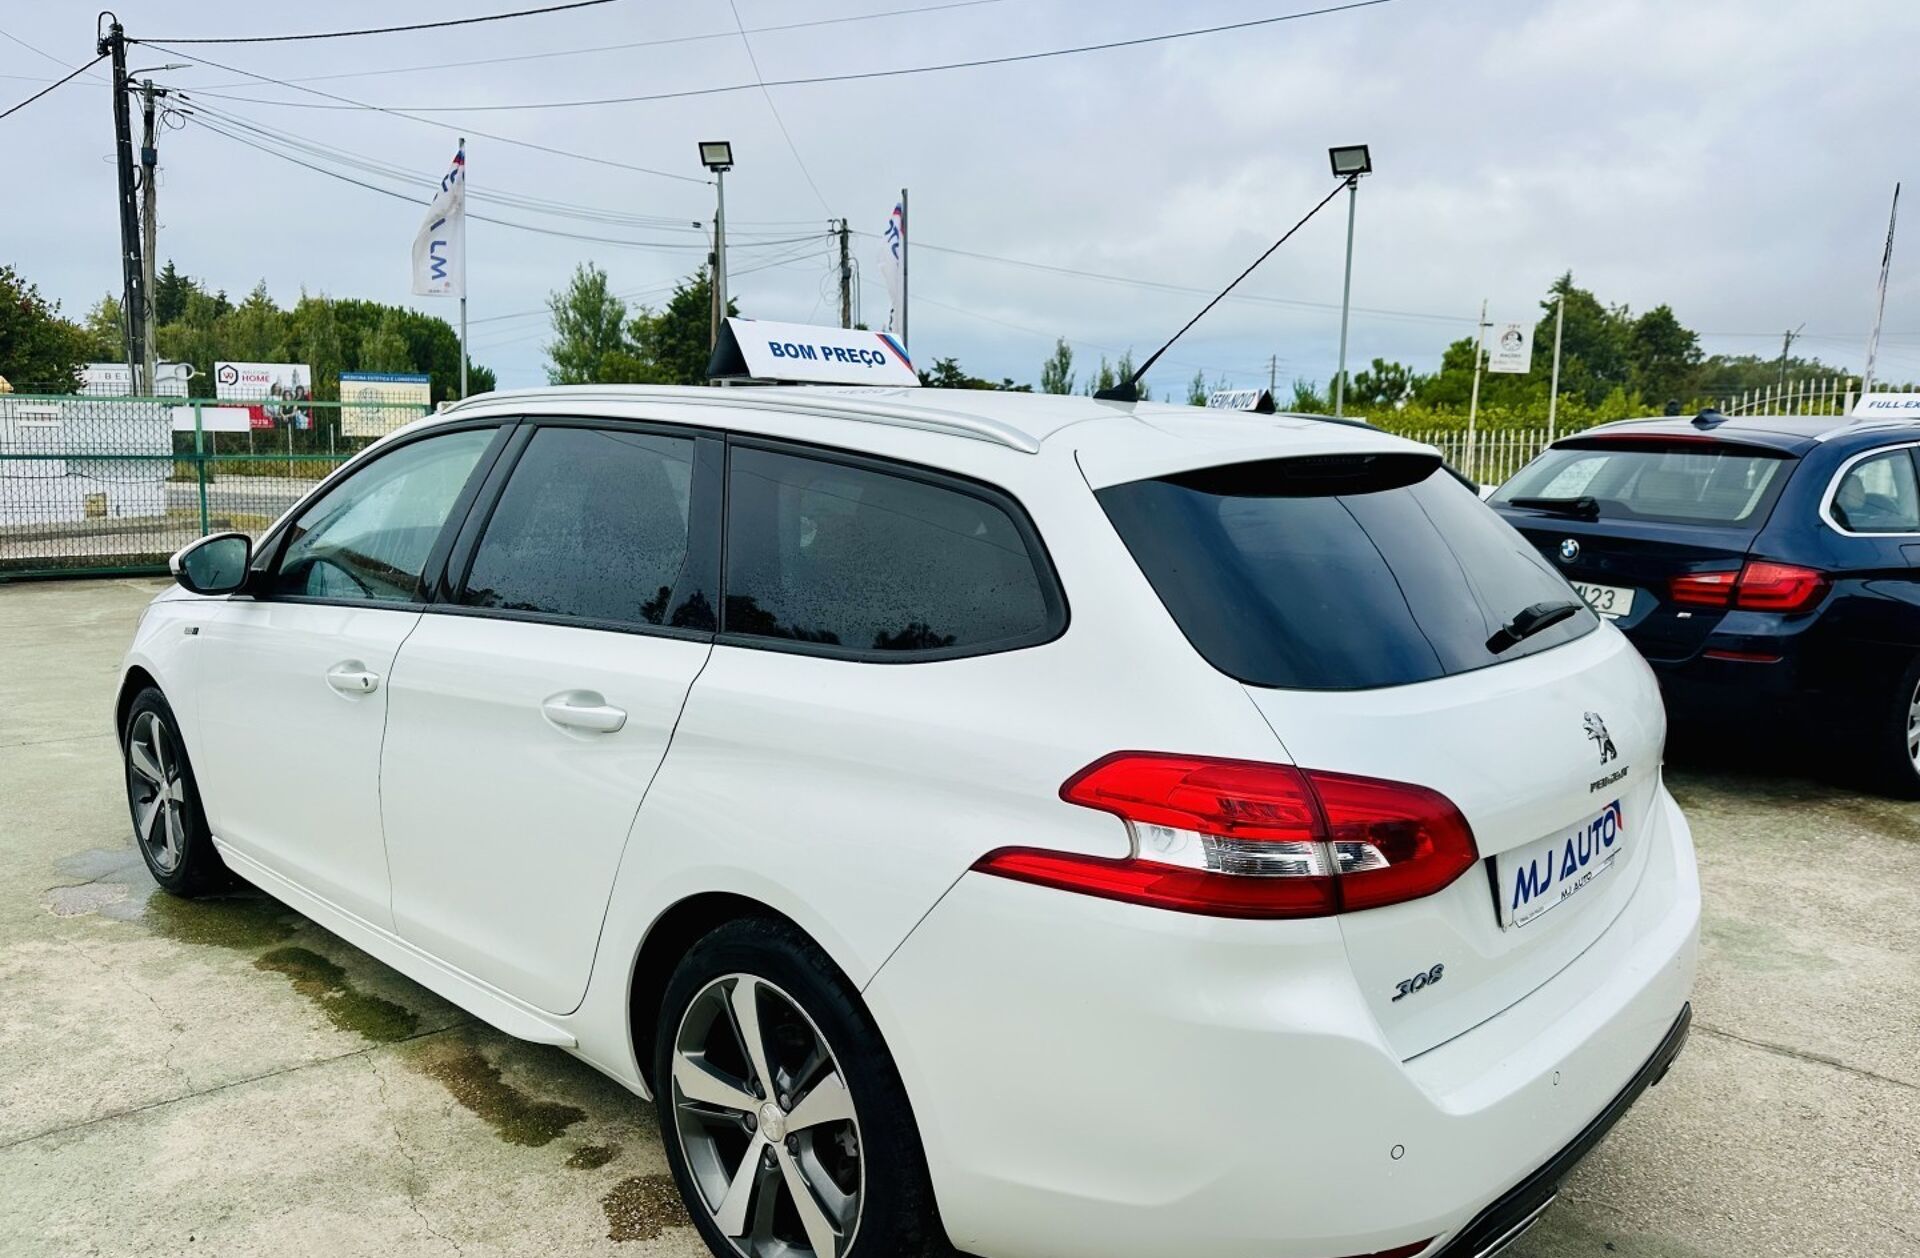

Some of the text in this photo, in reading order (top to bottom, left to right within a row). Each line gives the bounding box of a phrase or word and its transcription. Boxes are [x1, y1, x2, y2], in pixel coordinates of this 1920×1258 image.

[768, 341, 886, 368] BOM PREÇO
[1208, 392, 1256, 408] SEMI-NOVO
[1512, 809, 1615, 909] MJ AUTO
[1560, 871, 1593, 900] MJ AUTO
[1392, 963, 1444, 1002] 308
